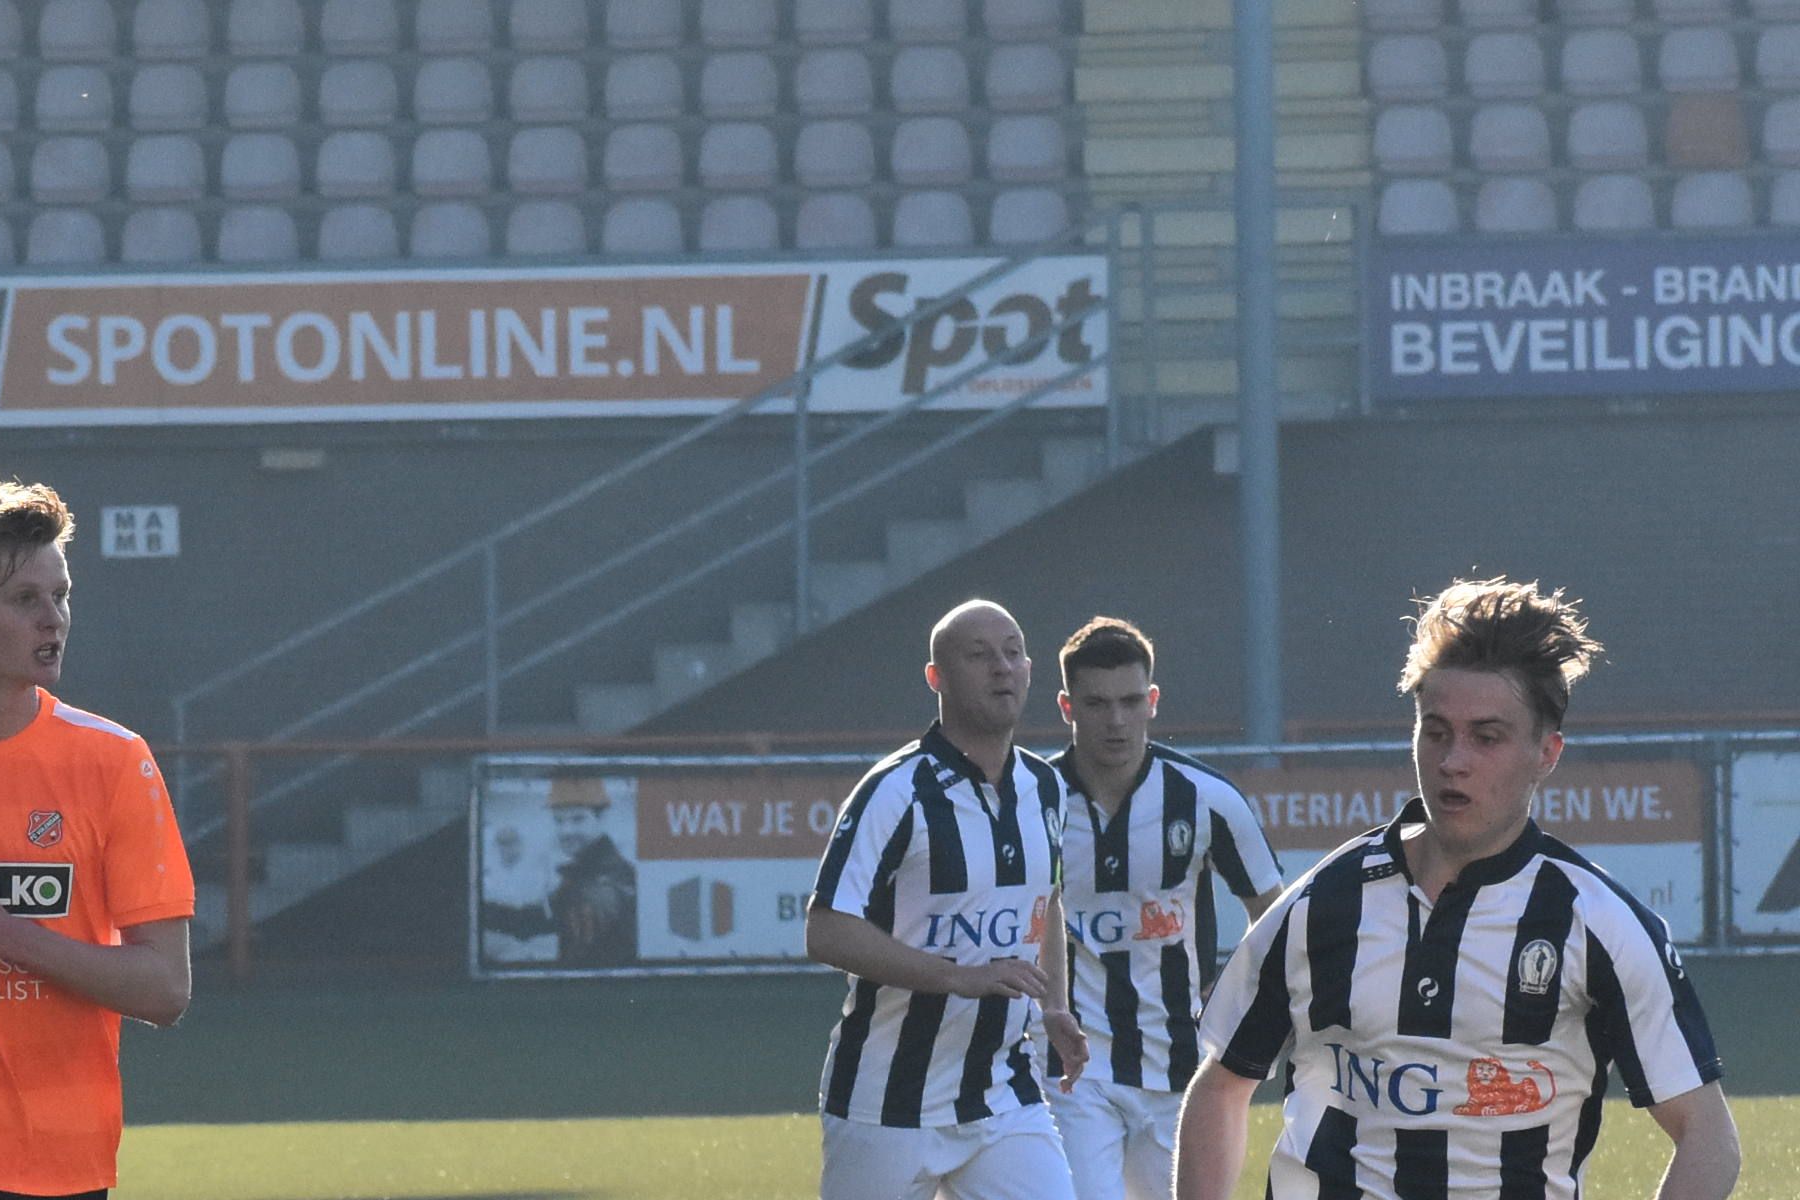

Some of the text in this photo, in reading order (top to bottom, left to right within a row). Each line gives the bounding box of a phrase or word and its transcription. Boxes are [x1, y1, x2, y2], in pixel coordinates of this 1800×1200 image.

[1391, 269, 1605, 311] INBRAAK
[1654, 264, 1800, 305] BRAN
[46, 304, 761, 386] SPOTONLINE.NL
[839, 271, 1101, 394] Spot
[665, 801, 746, 837] WAT
[759, 800, 794, 836] JE
[1602, 783, 1673, 822] WE.
[924, 907, 1021, 949] ING
[1065, 909, 1127, 945] NG
[1324, 1043, 1444, 1117] ING
